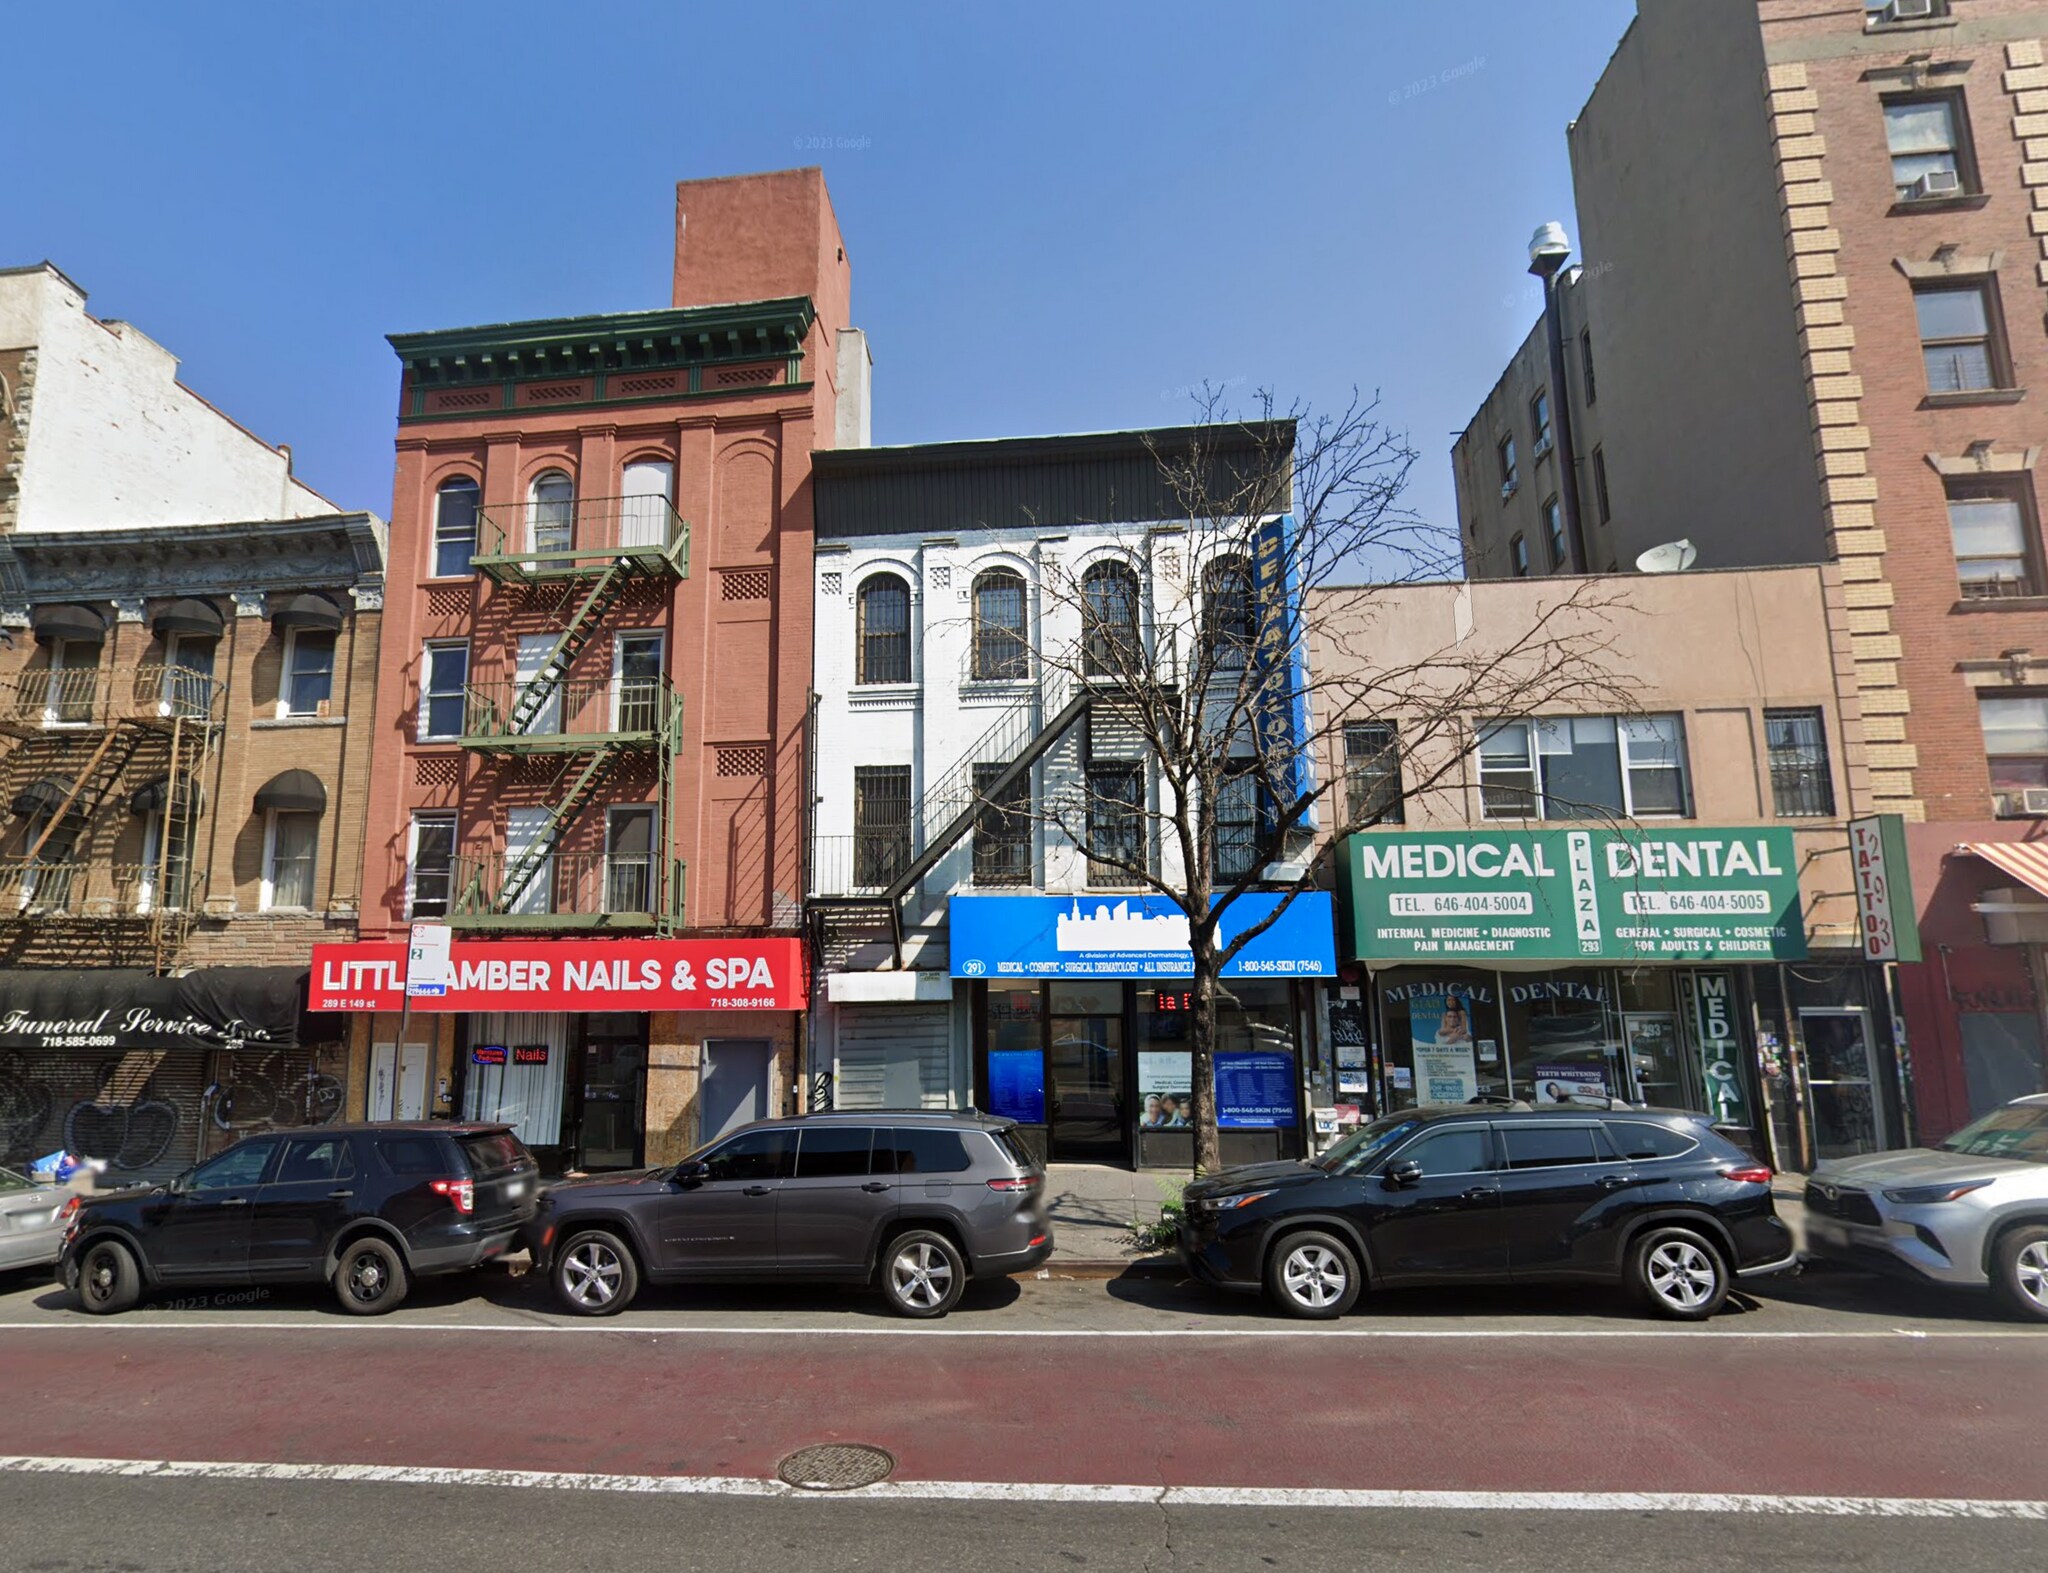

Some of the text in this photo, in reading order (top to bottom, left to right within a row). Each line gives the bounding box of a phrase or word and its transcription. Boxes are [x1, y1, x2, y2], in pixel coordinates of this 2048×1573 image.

[1363, 843, 1555, 879] MEDICAL
[1606, 840, 1783, 878] DENTAL
[1573, 838, 1597, 932] PLAZA
[1854, 827, 1882, 956] TATTOO
[1395, 896, 1527, 912] TEL. 646-404-5004
[1630, 894, 1765, 911] TEL. 646-404-5005
[1377, 927, 1551, 939] INTERNAL MEDICINE DIAGNOSTIC
[1616, 926, 1787, 938] GENERAL SURGICAL COSMETIC
[1414, 940, 1515, 951] PAIN MANAGEMENT
[1581, 941, 1600, 952] 293
[1634, 940, 1771, 951] FOR ADULTS & CHILDREN
[412, 949, 421, 959] 2
[967, 963, 982, 973] 291
[997, 962, 1024, 973] MEDICAL
[1029, 962, 1060, 973] COSMETIC
[1065, 962, 1094, 973] SURGICAL
[1094, 962, 1139, 973] DERMATOLOGY
[1144, 962, 1155, 972] ALL
[1156, 961, 1191, 972] INSURANCE
[1238, 960, 1322, 973] 1-800-545-SKIN (7546)
[322, 957, 775, 991] LITTL AMBER NAILS & SPA
[1385, 982, 1493, 1004] MEDICAL
[1510, 982, 1610, 1003] DENTAL
[322, 999, 376, 1008] 289 E 149 st
[710, 998, 776, 1008] 718-308-9166
[0, 1007, 271, 1042] Funeral Service Inc.
[1641, 1024, 1662, 1037] 293
[42, 1035, 116, 1047] 718-585-0699
[516, 1048, 547, 1061] Nails
[1700, 977, 1740, 1123] MEDICAL
